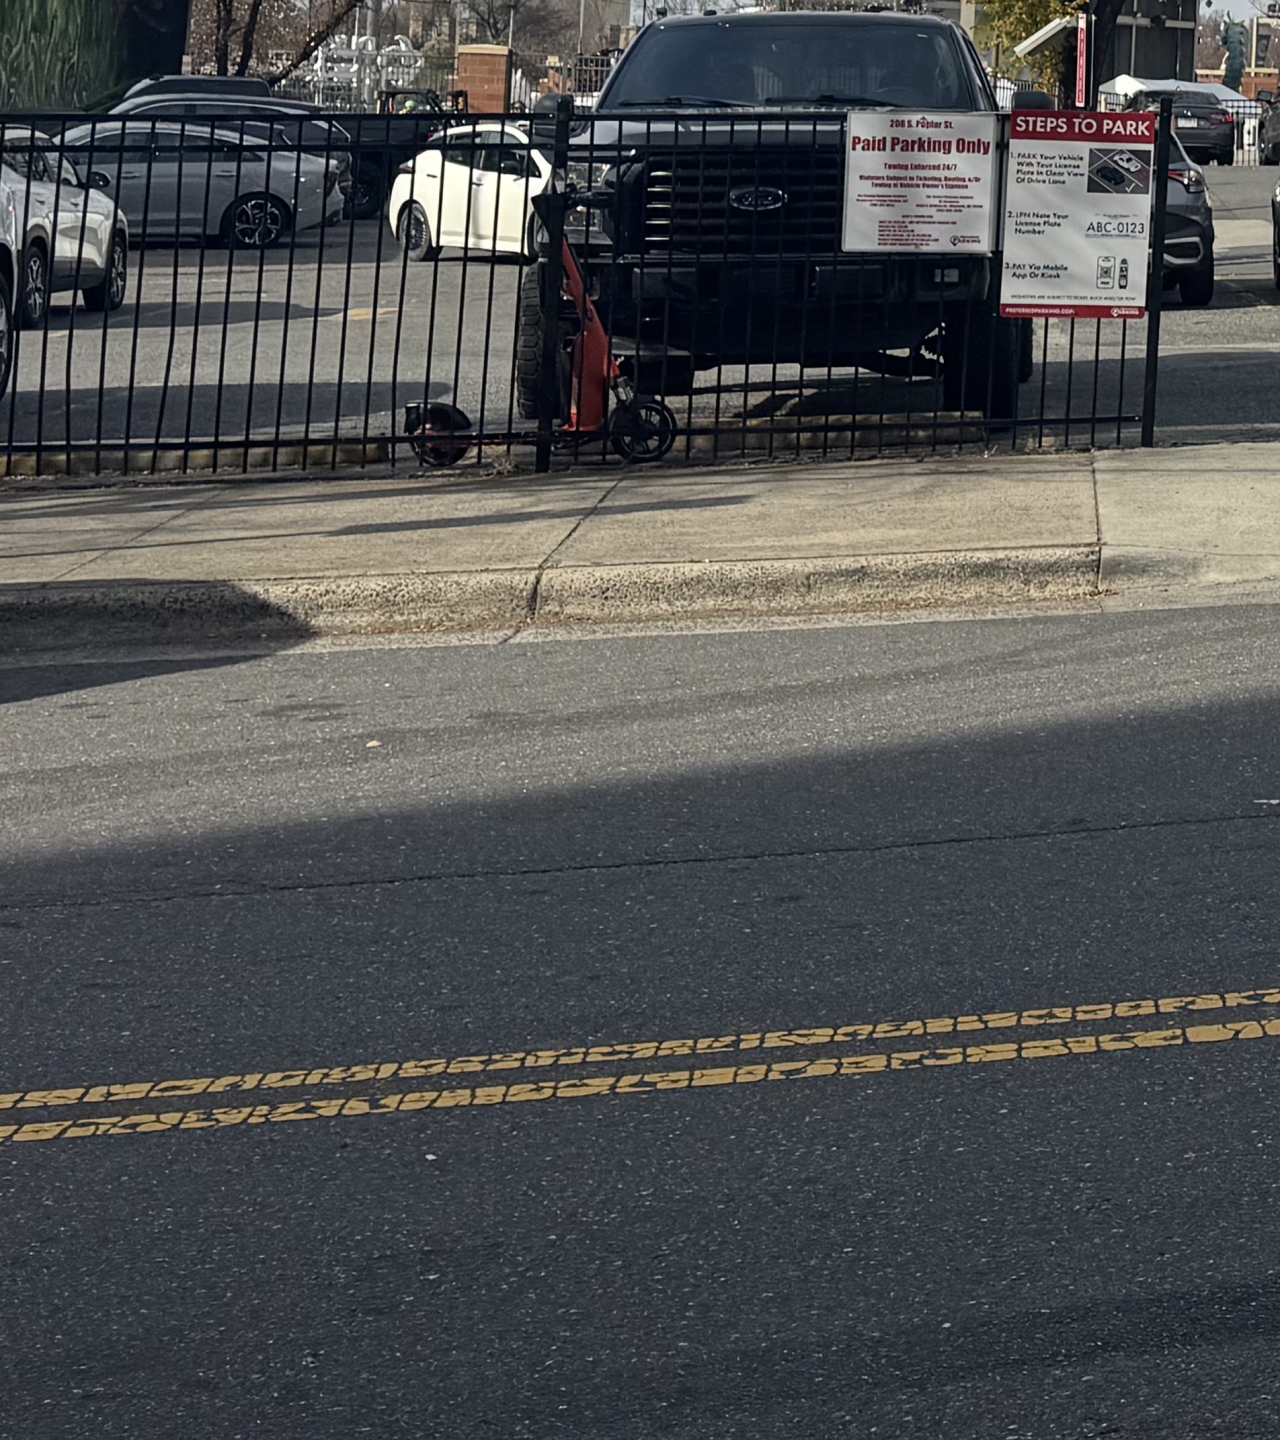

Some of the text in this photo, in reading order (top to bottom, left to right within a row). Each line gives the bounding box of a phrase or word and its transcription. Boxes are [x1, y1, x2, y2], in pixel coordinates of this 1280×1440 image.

[890, 120, 954, 129] 208 S. Poplar St.
[1016, 116, 1150, 136] STEPS TO PARK
[851, 136, 990, 155] Paid Parking Only
[884, 163, 909, 171] Towing
[910, 163, 941, 171] Enforced
[1086, 221, 1145, 234] ABC-0123
[1012, 263, 1026, 271] PAY
